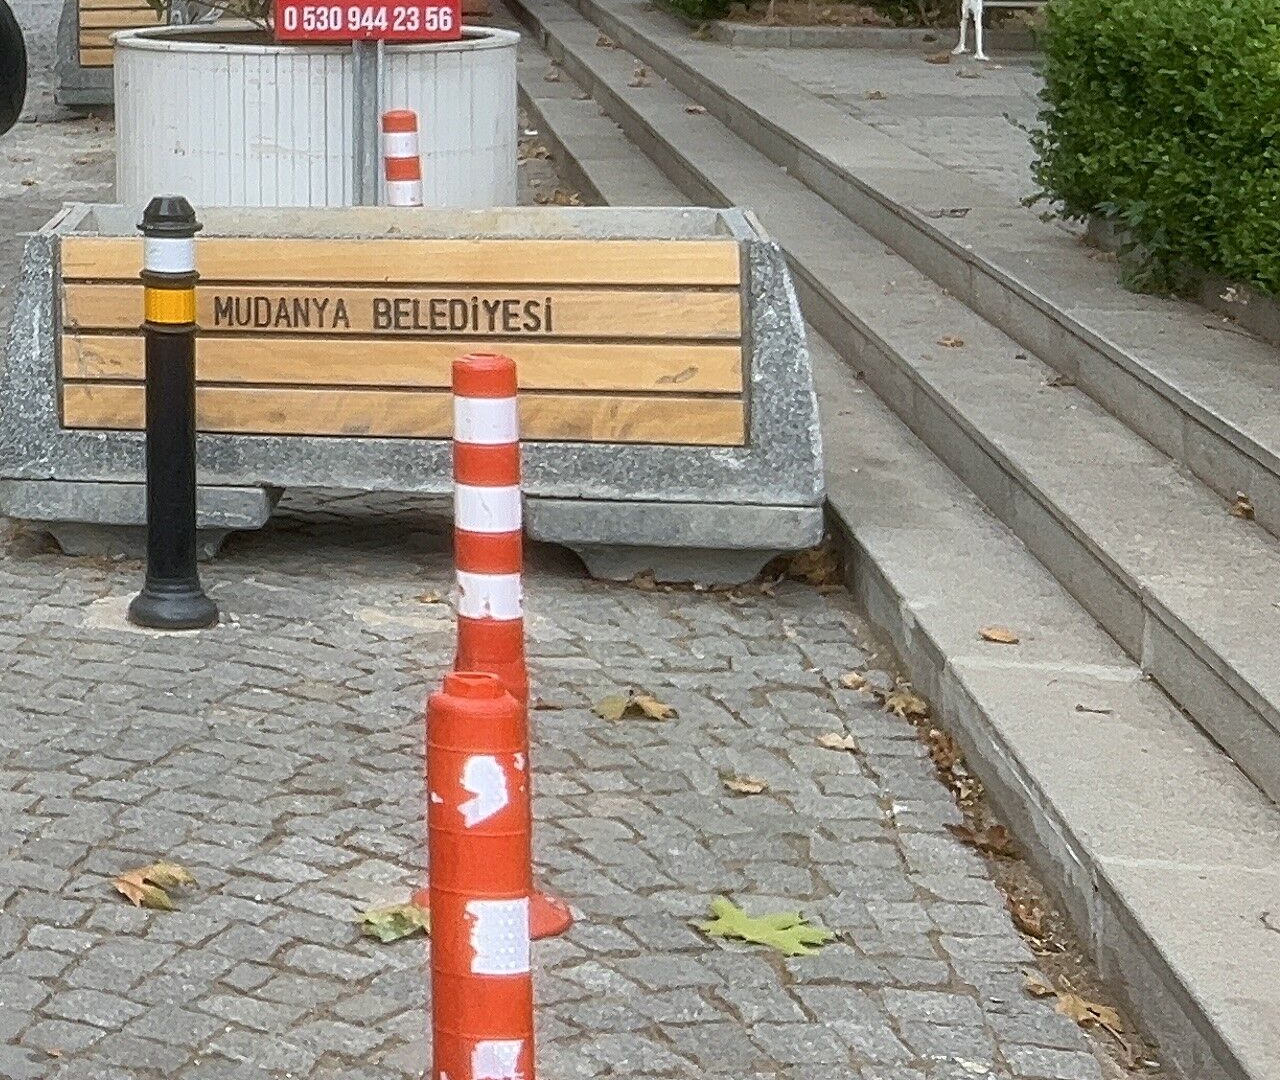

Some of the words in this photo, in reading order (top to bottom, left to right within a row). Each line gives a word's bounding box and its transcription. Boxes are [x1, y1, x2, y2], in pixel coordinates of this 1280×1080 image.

[283, 6, 298, 32] 0
[302, 6, 342, 32] 530
[347, 6, 388, 32] 944
[393, 6, 420, 32] 23
[424, 6, 453, 32] 56
[213, 296, 352, 329] MUDANYA
[372, 296, 553, 332] BELEDİYESİ
